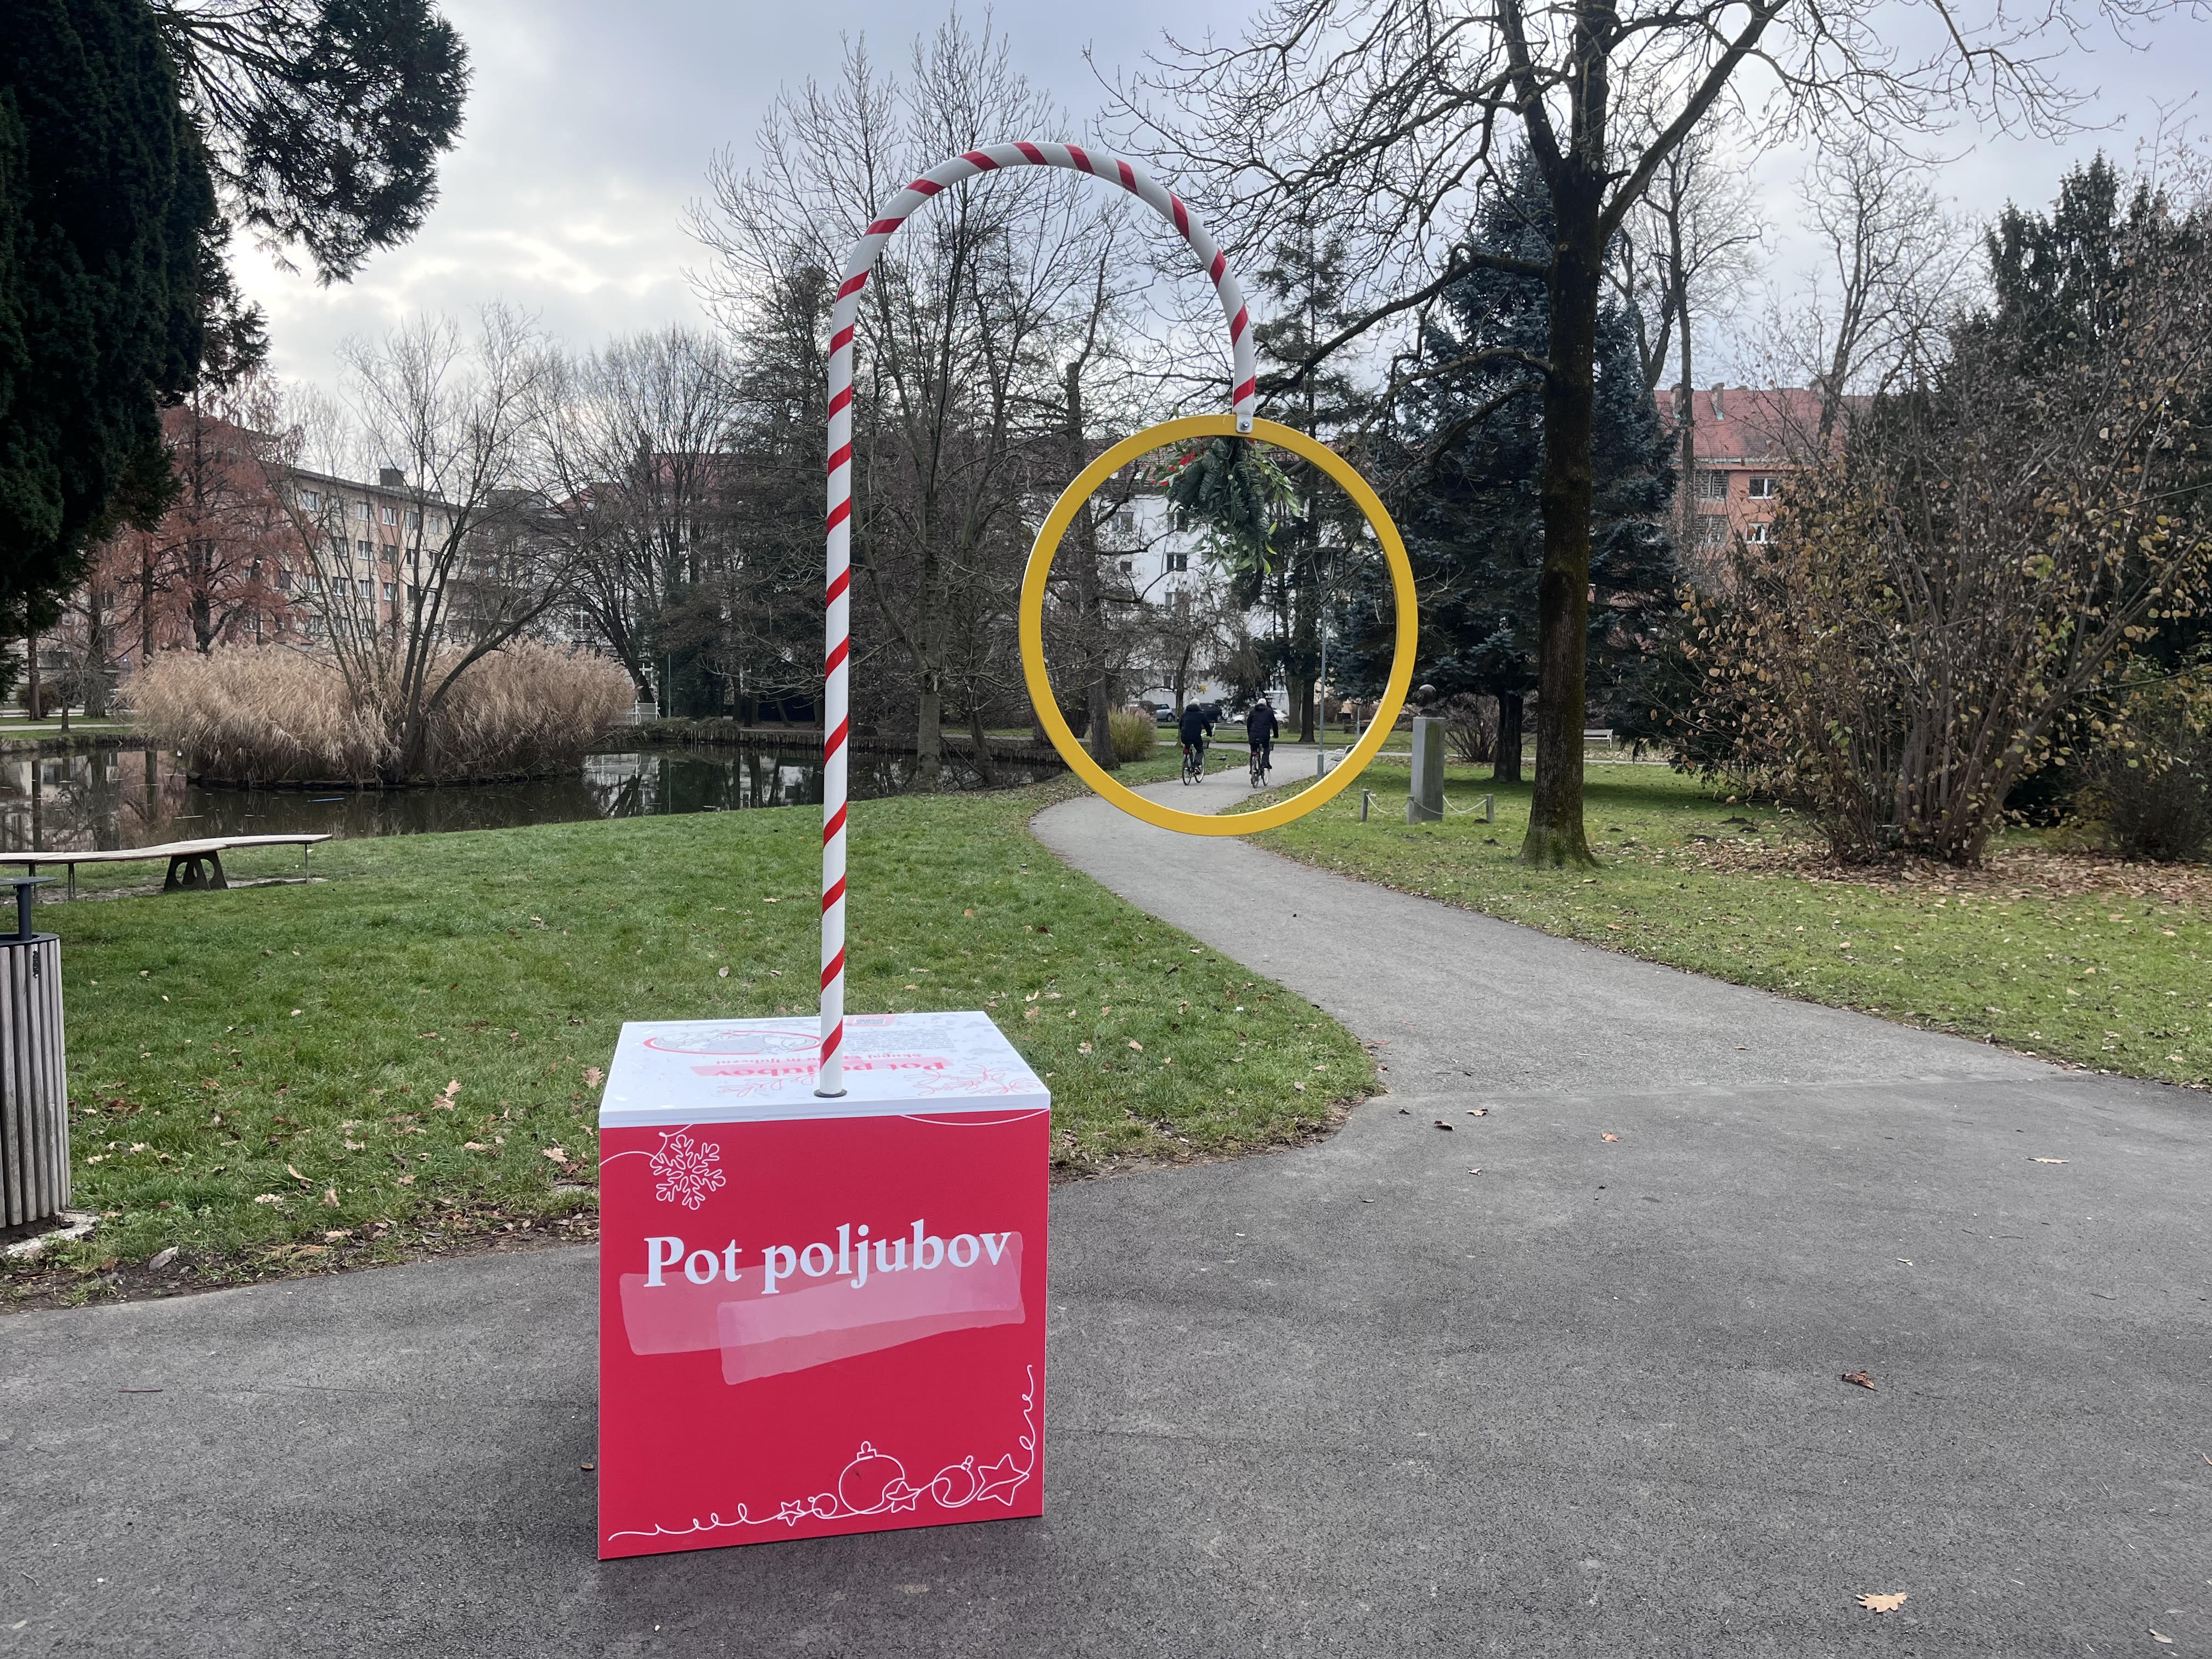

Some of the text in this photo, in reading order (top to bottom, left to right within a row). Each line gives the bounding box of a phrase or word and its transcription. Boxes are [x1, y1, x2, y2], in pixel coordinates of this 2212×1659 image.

[714, 1062, 945, 1076] Pot pjubov
[644, 1218, 1011, 1295] Pot poljubov
